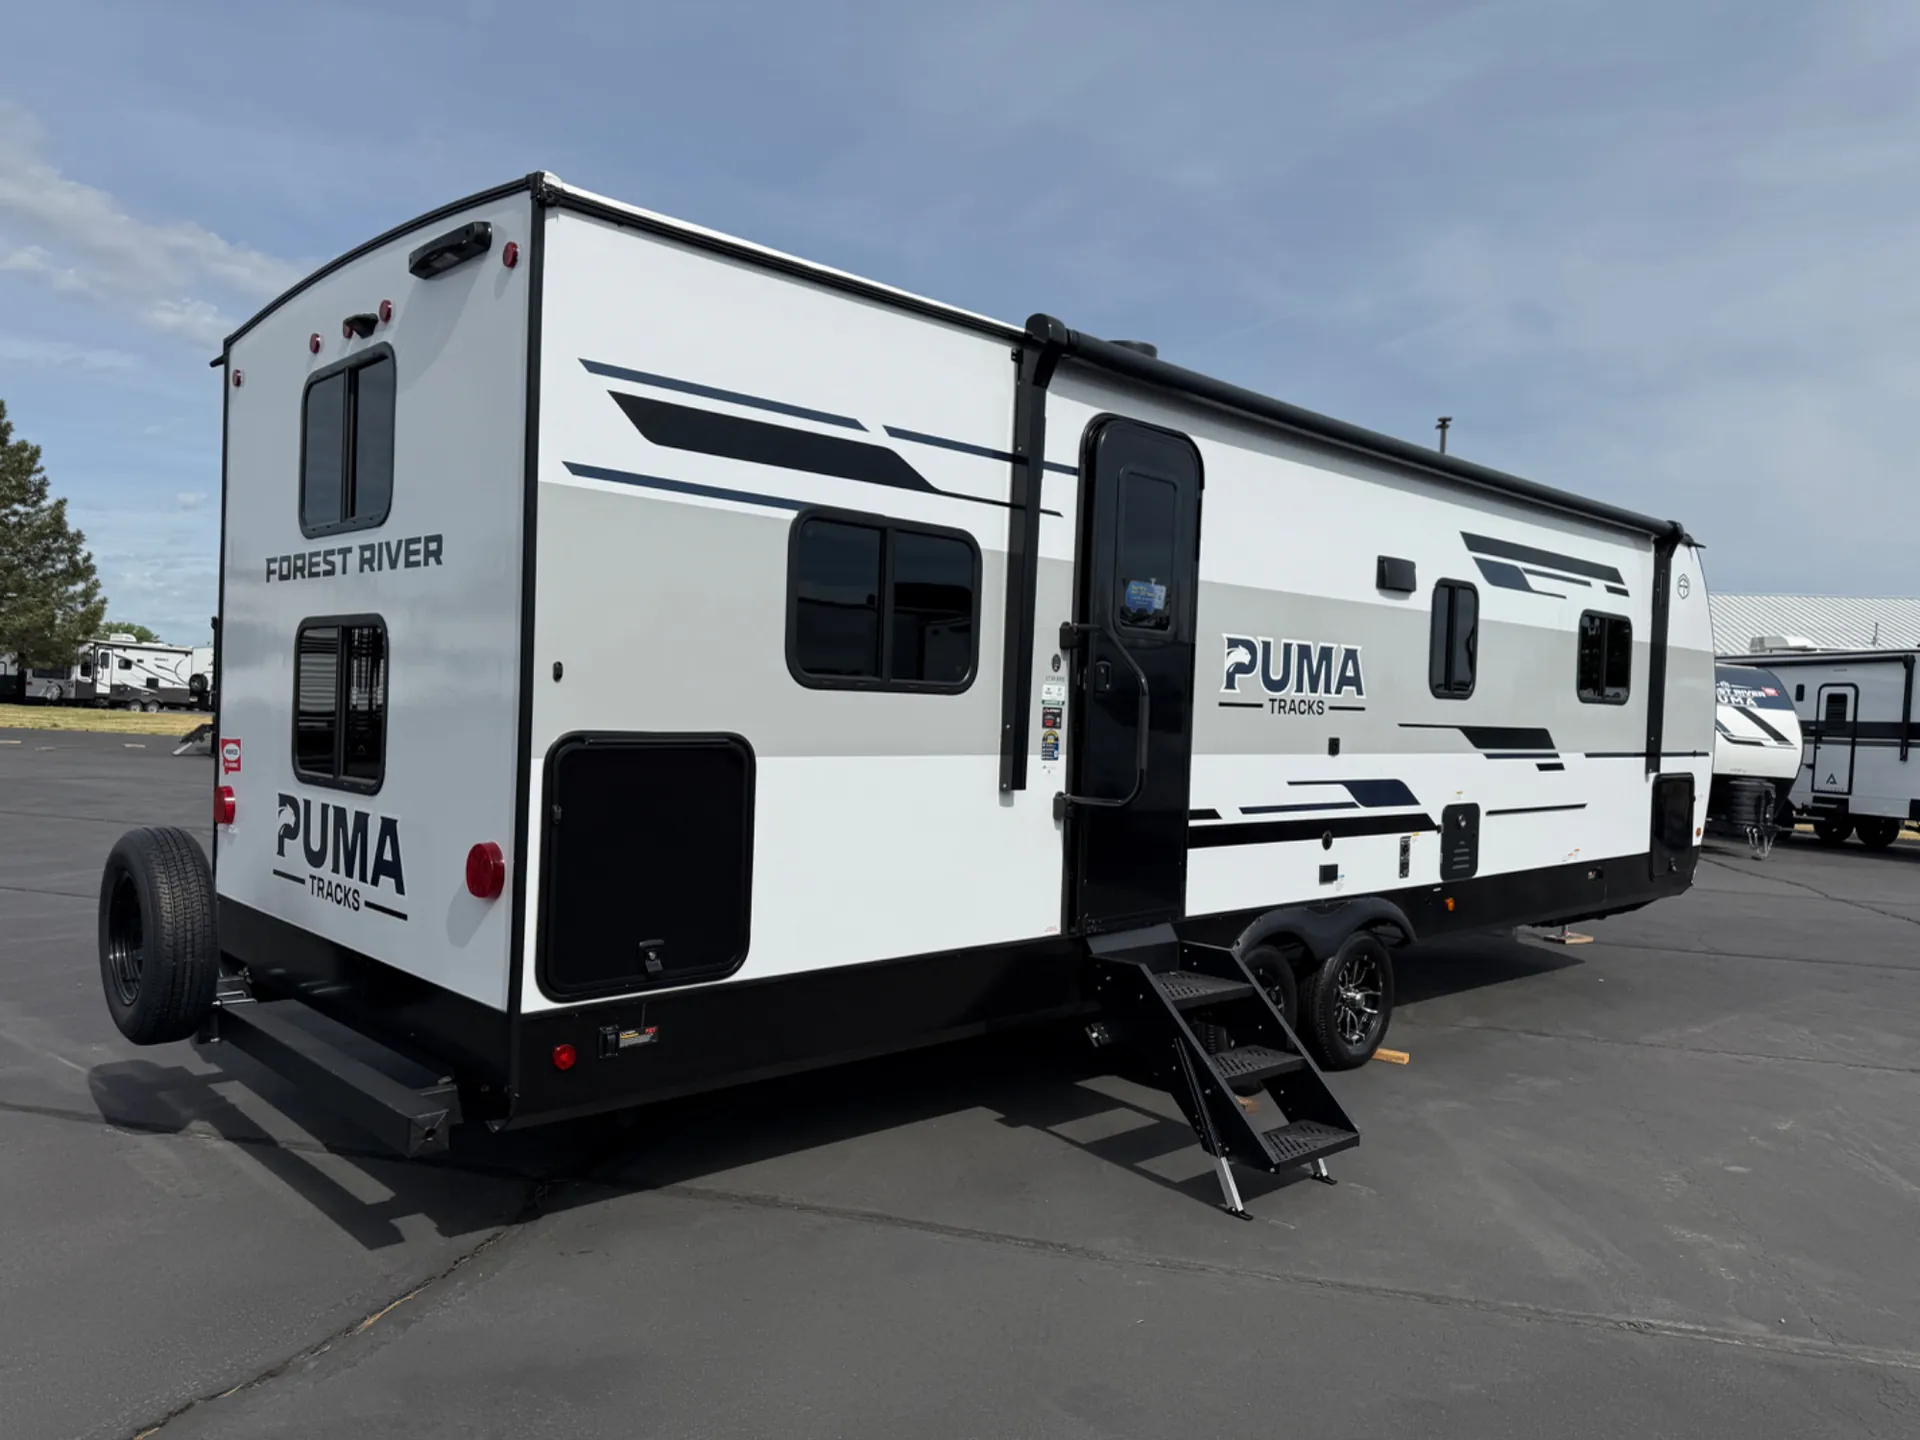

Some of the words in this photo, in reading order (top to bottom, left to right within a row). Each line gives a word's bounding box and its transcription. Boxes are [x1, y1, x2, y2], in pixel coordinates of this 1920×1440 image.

[265, 546, 353, 583] FOREST
[358, 533, 443, 573] RIVER
[1221, 634, 1366, 698] PUMA
[1268, 697, 1325, 716] TRACKS
[1716, 692, 1758, 708] UMA
[276, 792, 406, 896] PUMA
[308, 873, 361, 912] TRACKS
